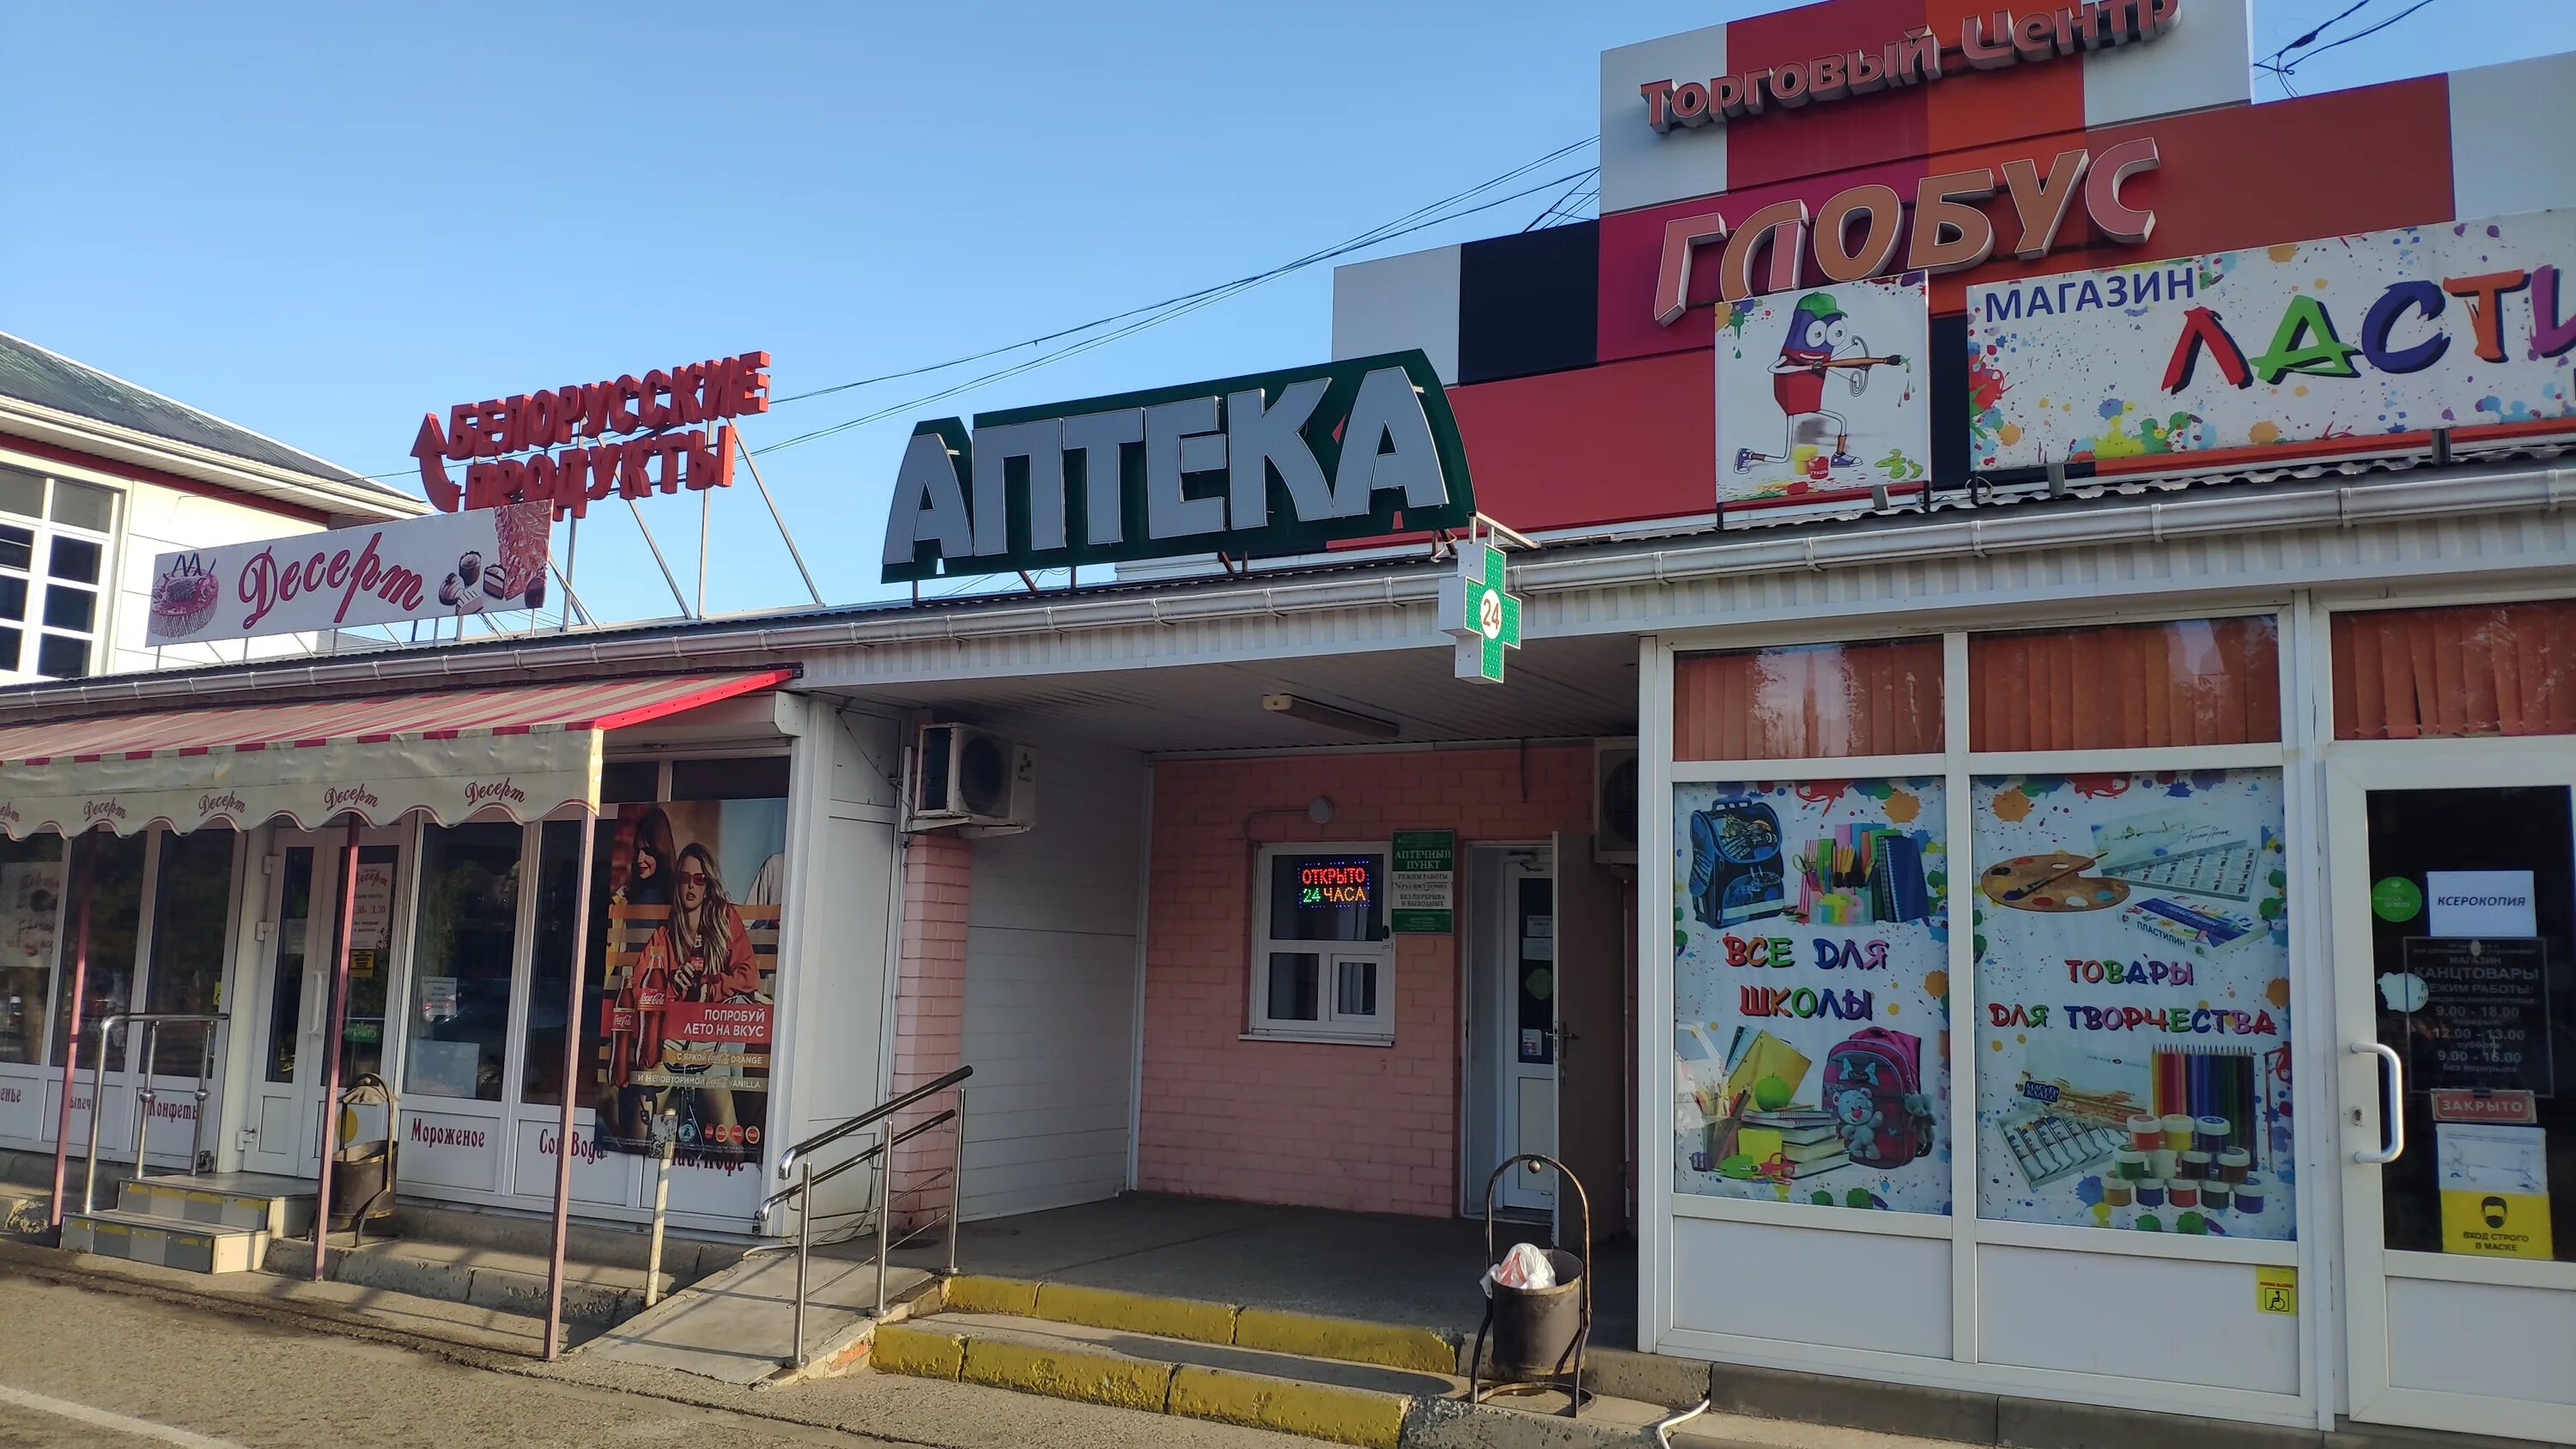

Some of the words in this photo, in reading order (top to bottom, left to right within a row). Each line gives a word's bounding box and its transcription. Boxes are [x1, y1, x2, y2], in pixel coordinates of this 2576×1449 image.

[1640, 25, 1941, 134] Торговый
[1961, 0, 2182, 70] Центр
[1654, 136, 2160, 326] ГЛОБУС
[1984, 267, 2196, 323] МАГАЗИН
[447, 350, 771, 460] БЕЛОРУССКИЕ
[465, 426, 736, 522] ПРОДУКТЫ
[882, 366, 1449, 565] АПТЕКА
[238, 531, 424, 630] Десерт
[1482, 598, 1500, 630] 24
[324, 783, 380, 811] Десерт
[465, 777, 526, 806] Десерт
[83, 797, 127, 822] Десерт
[198, 791, 246, 816] Десерт
[1394, 848, 1451, 859] АПТЕЧНЫЙ
[1406, 860, 1441, 870] ПУНКТ
[1302, 866, 1366, 885] ОТКРЫТО
[1303, 888, 1321, 903] 24
[1323, 886, 1366, 902] ЧАСА
[2437, 896, 2526, 906] КСЕРОКОПИЯ
[2136, 921, 2186, 948] ПЛАСТИЛИН
[1722, 935, 1796, 968] ВСЕ
[1813, 937, 1890, 970] ДЛЯ
[2449, 955, 2502, 965] МАГАЗИН
[2064, 959, 2194, 986] ТОВАРЫ
[2415, 967, 2539, 980] КАНЦТОВАРЫ
[2421, 983, 2469, 994] РЕЖИМ
[1740, 985, 1873, 1021] ШКОЛЫ
[2436, 1005, 2466, 1016] 9.00
[2482, 1006, 2519, 1017] 18.00
[704, 1008, 766, 1023] ПОПРОБУЙ
[1988, 1003, 2050, 1028] ДЛЯ
[2063, 1005, 2277, 1035] ТВОРЧЕСТВА
[683, 1023, 714, 1035] ЛЕТО
[715, 1025, 731, 1036] НА
[733, 1025, 764, 1037] ВКУС
[731, 1056, 762, 1064] ORANGE
[2437, 1051, 2468, 1061] 9.00
[638, 1074, 643, 1082] И
[646, 1075, 705, 1085] НЕПОВТОРИМОЙ
[731, 1079, 761, 1088] VANILLA
[70, 1095, 91, 1109] ыпеч
[2026, 1089, 2057, 1100] КЛАСС
[2442, 1100, 2524, 1113] ЗАКРЫТО
[410, 1118, 485, 1149] Мороженое
[2463, 1231, 2488, 1240] ВХОД
[2491, 1233, 2529, 1242] СТРОГО
[2486, 1243, 2518, 1252] МАСКЕ
